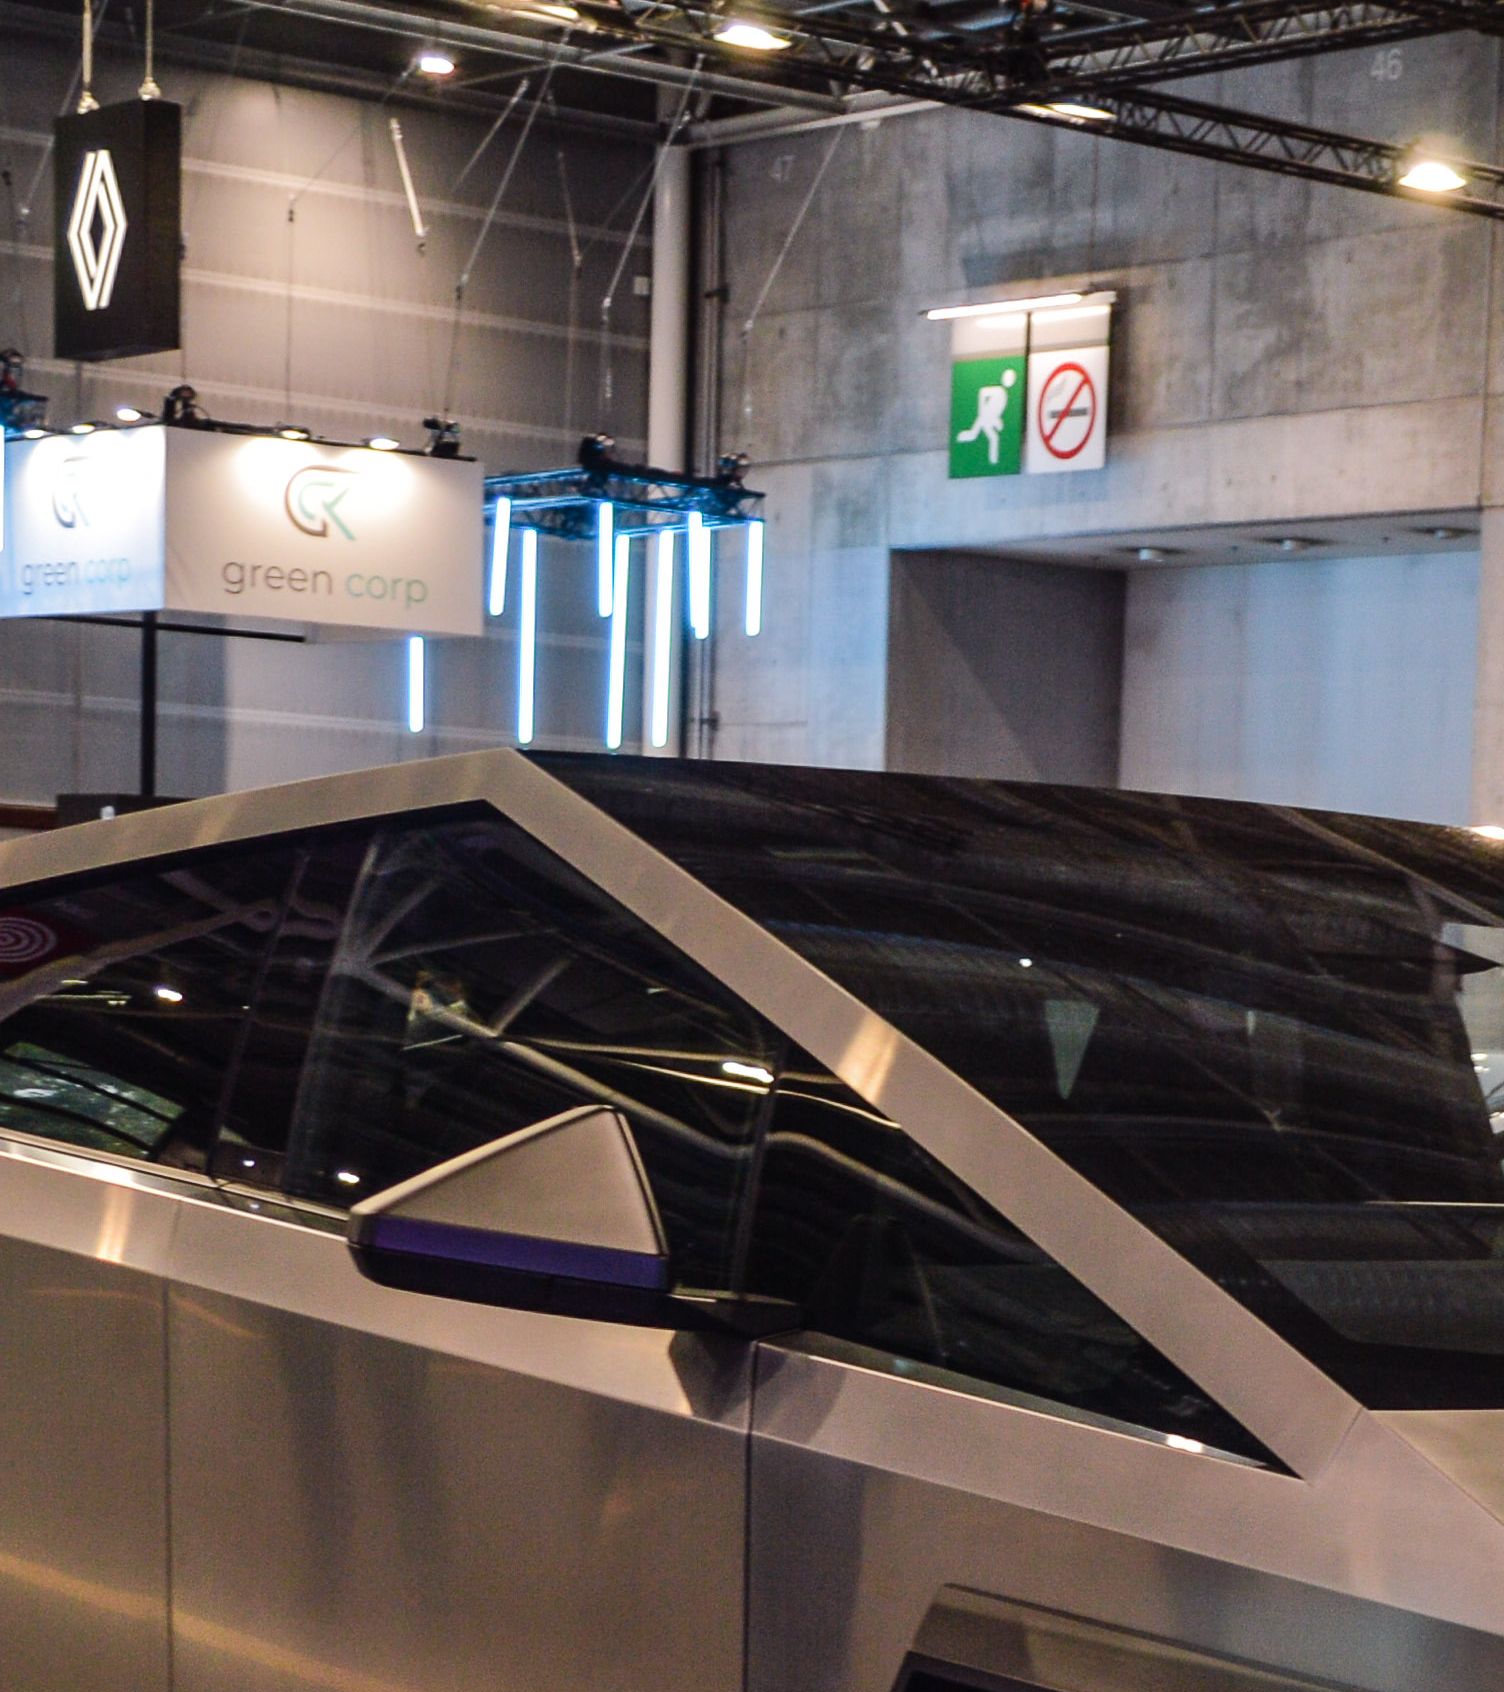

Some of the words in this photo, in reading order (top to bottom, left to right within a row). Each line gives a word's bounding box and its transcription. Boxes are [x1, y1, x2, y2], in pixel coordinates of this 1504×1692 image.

[1371, 48, 1402, 81] 46
[222, 560, 333, 596] green
[345, 572, 429, 609] corp
